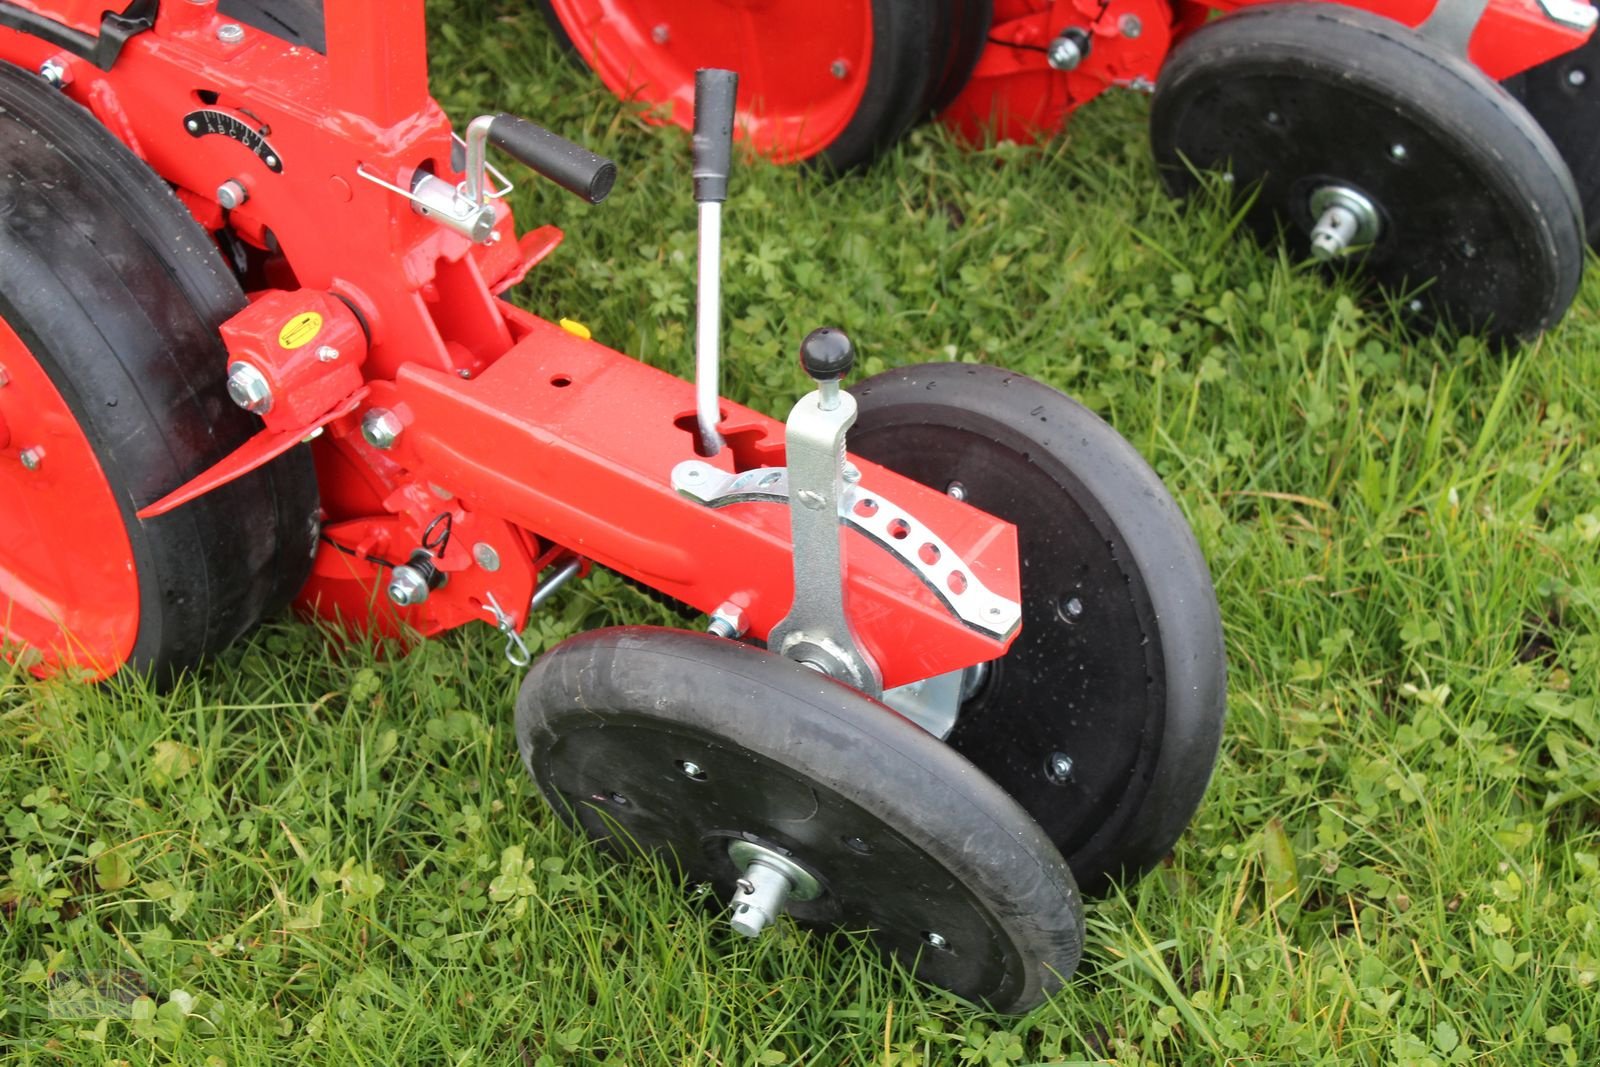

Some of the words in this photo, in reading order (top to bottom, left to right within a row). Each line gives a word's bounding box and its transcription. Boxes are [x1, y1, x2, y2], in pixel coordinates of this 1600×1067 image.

[208, 123, 216, 133] A
[217, 125, 225, 134] B
[229, 129, 237, 138] C
[242, 136, 250, 145] D
